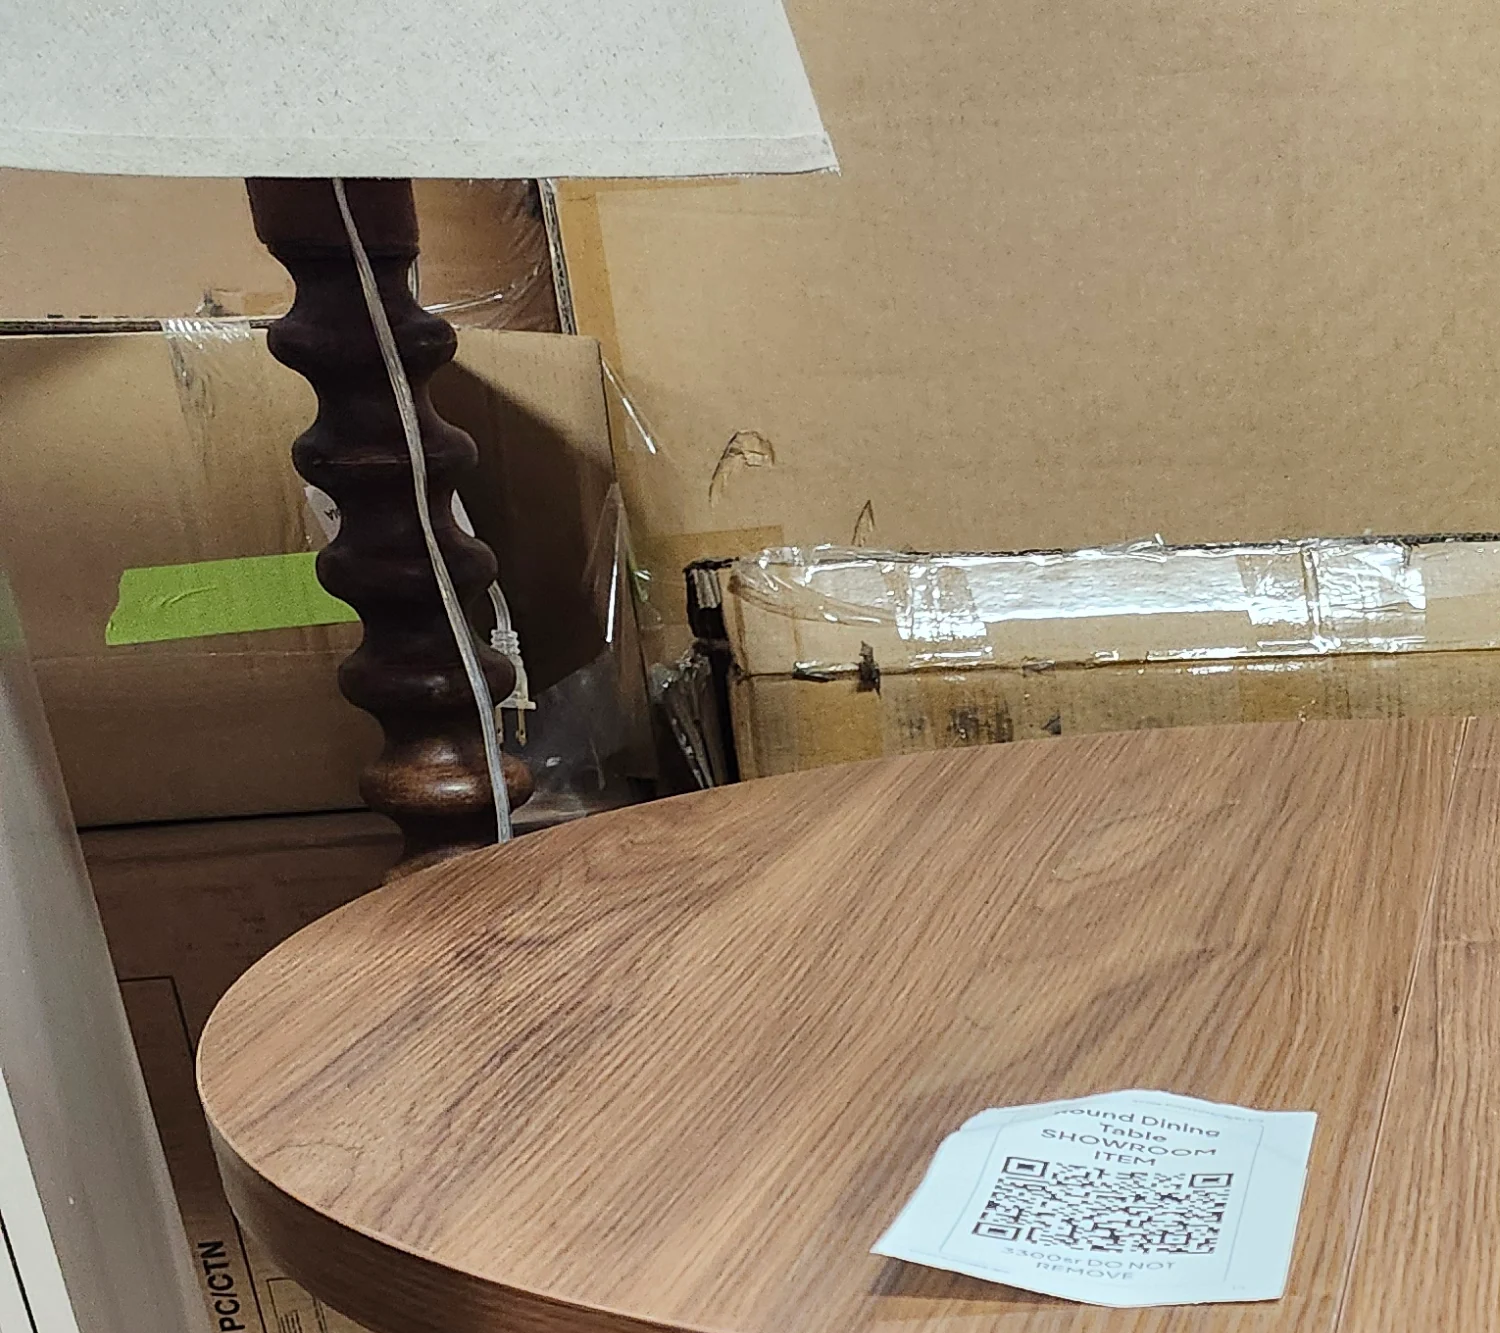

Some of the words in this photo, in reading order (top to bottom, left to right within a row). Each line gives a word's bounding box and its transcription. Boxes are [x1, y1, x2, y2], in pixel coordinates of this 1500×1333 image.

[1100, 1123, 1167, 1142] Table
[1141, 1116, 1221, 1137] Dining
[1041, 1129, 1216, 1156] SHOWROOM
[1094, 1151, 1156, 1166] ITEM
[1036, 1261, 1134, 1280] REMOVE
[1088, 1258, 1123, 1269] DO
[1129, 1260, 1177, 1271] NOT
